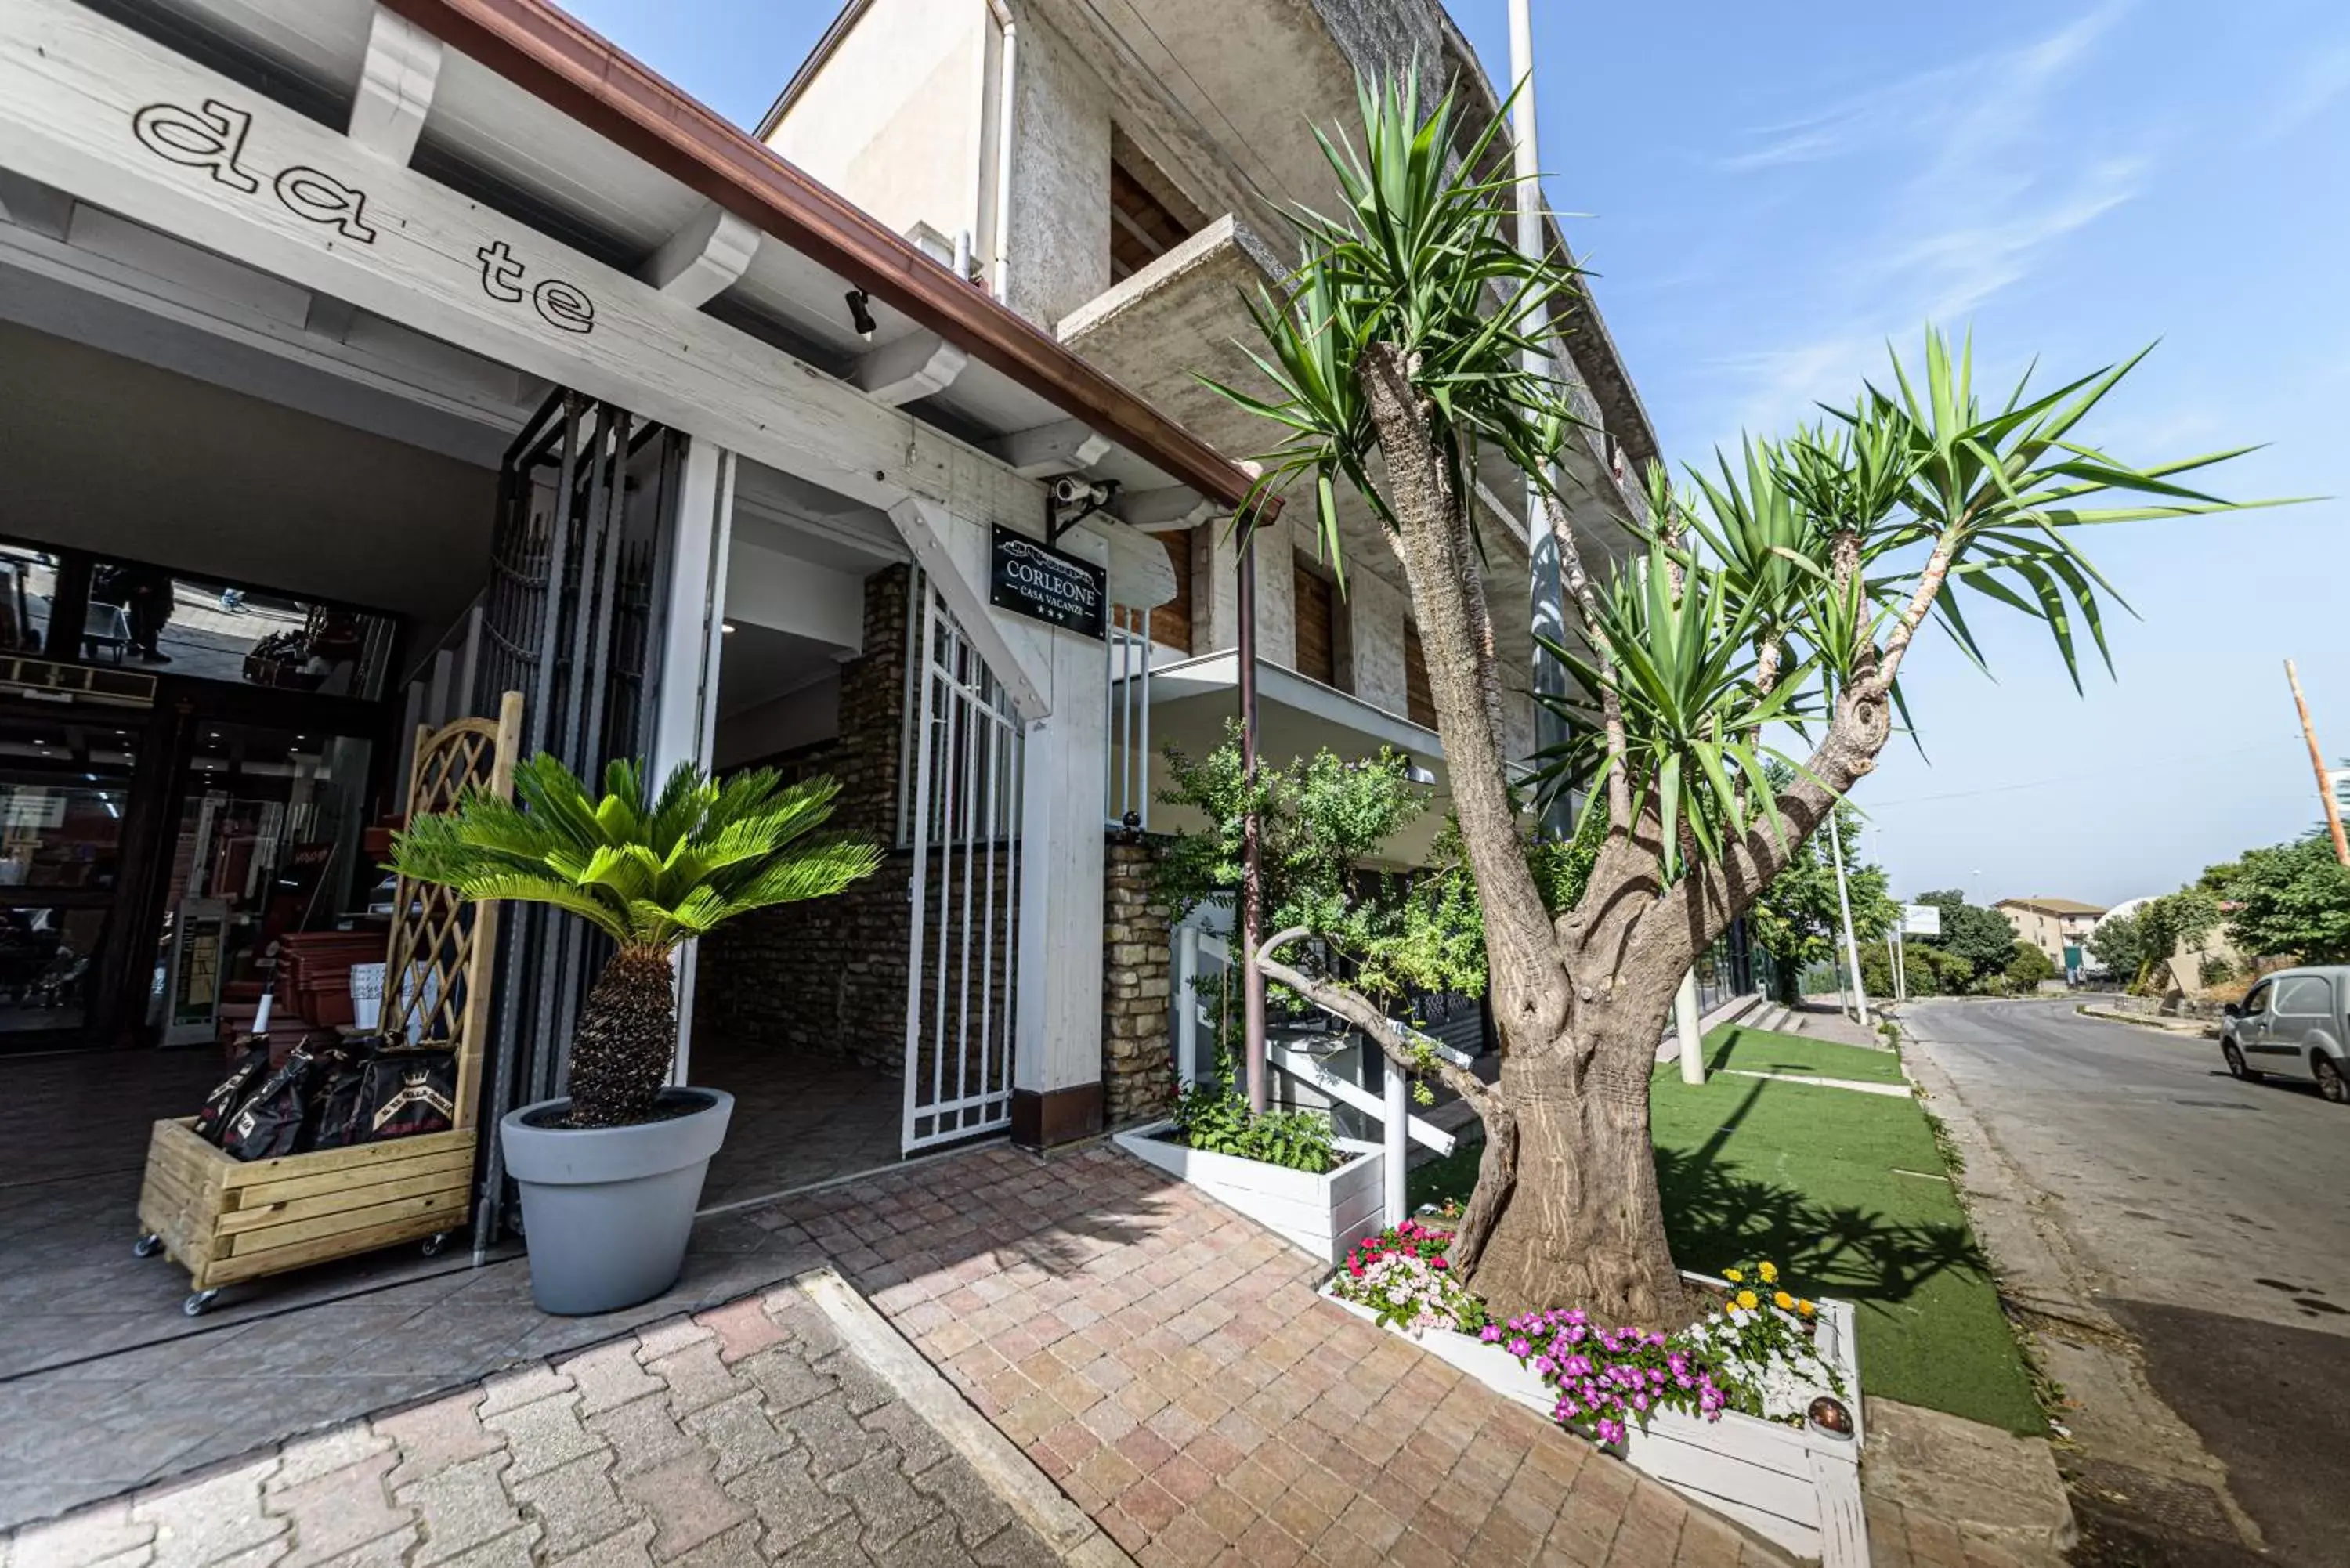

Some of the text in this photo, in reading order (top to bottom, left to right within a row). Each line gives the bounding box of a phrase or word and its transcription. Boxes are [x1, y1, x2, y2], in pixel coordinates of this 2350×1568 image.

[132, 99, 595, 334] da te
[1007, 560, 1095, 606] CORLEONE
[1021, 586, 1083, 615] CASA VACANZE
